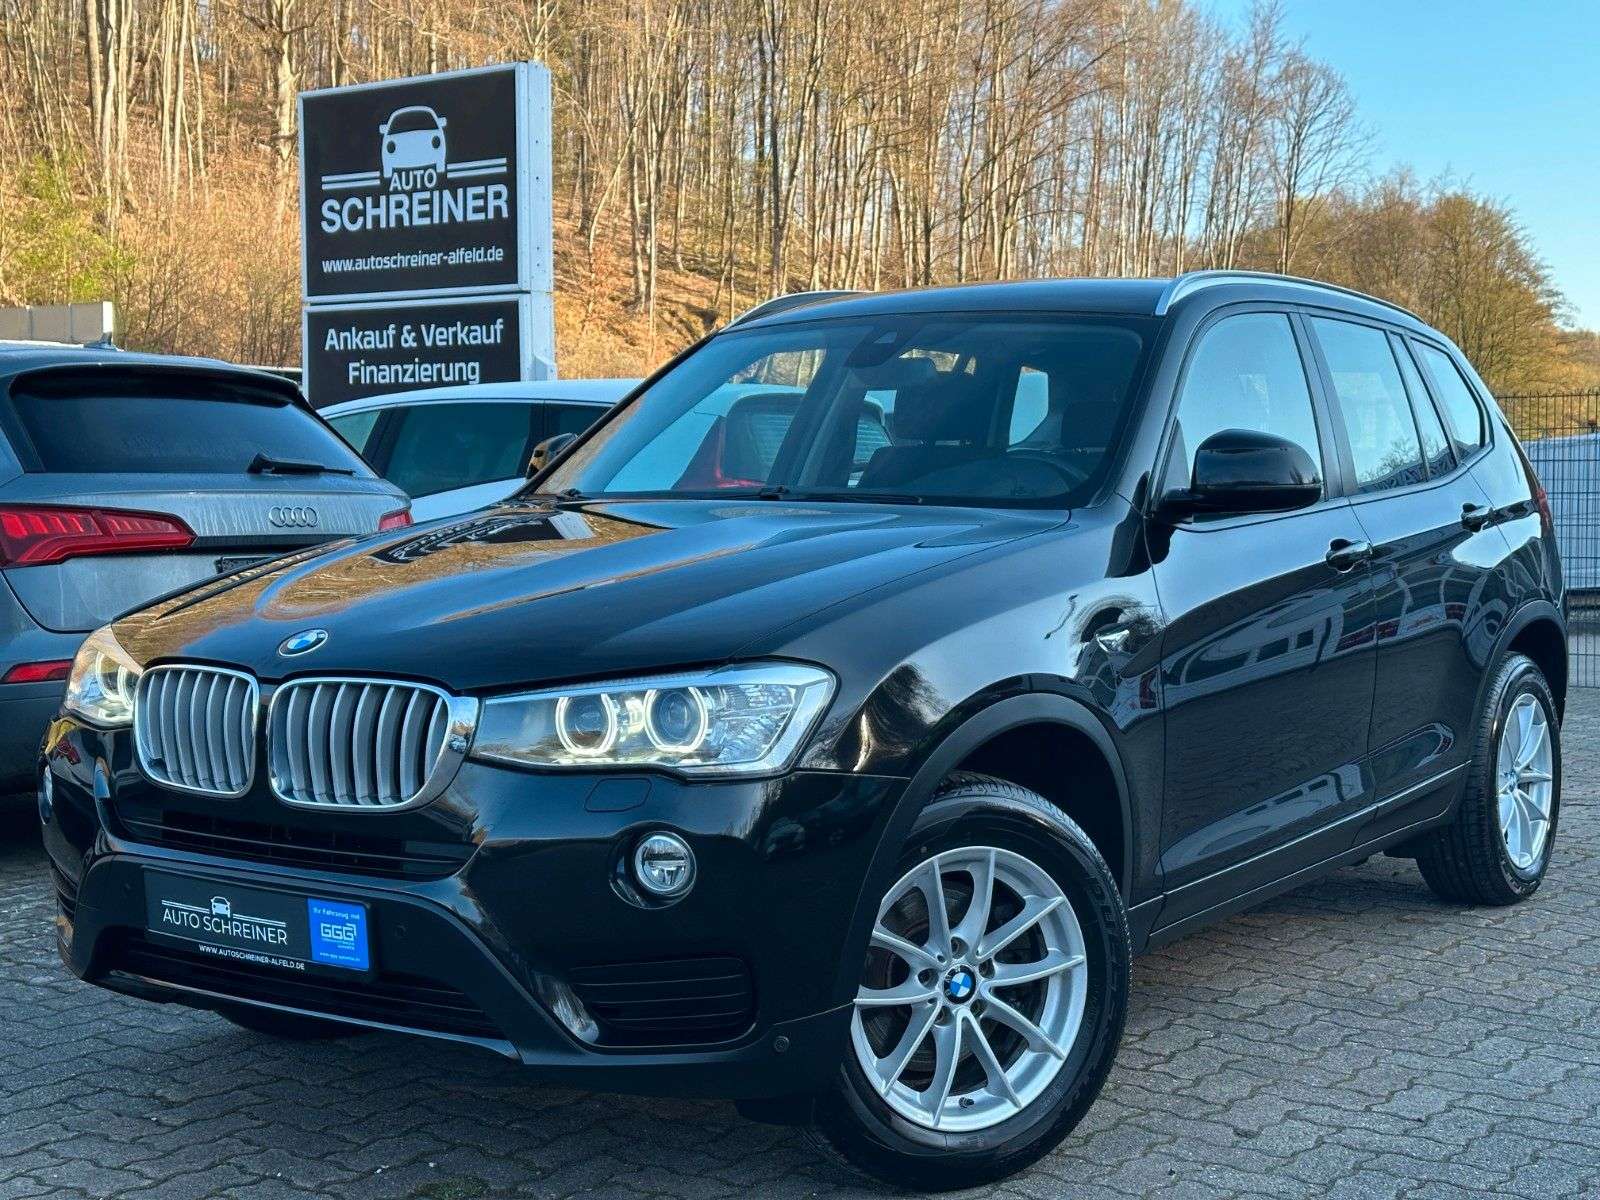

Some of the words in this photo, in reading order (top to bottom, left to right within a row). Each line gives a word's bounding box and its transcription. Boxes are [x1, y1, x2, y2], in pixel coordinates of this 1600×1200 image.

[389, 168, 437, 191] AUTO
[321, 184, 508, 233] SCHREINER
[322, 246, 503, 273] www.autoschreiner-alfeld.de
[324, 323, 396, 352] Ankauf
[400, 327, 417, 348] &
[420, 318, 504, 347] Verkauf
[348, 358, 480, 386] Finanzierung
[162, 907, 200, 929] AUTO
[202, 915, 288, 946] SCHREINER
[320, 922, 355, 942] GGG
[199, 944, 305, 970] WWW.AUTOSCHREINER-ALFELD.DE
